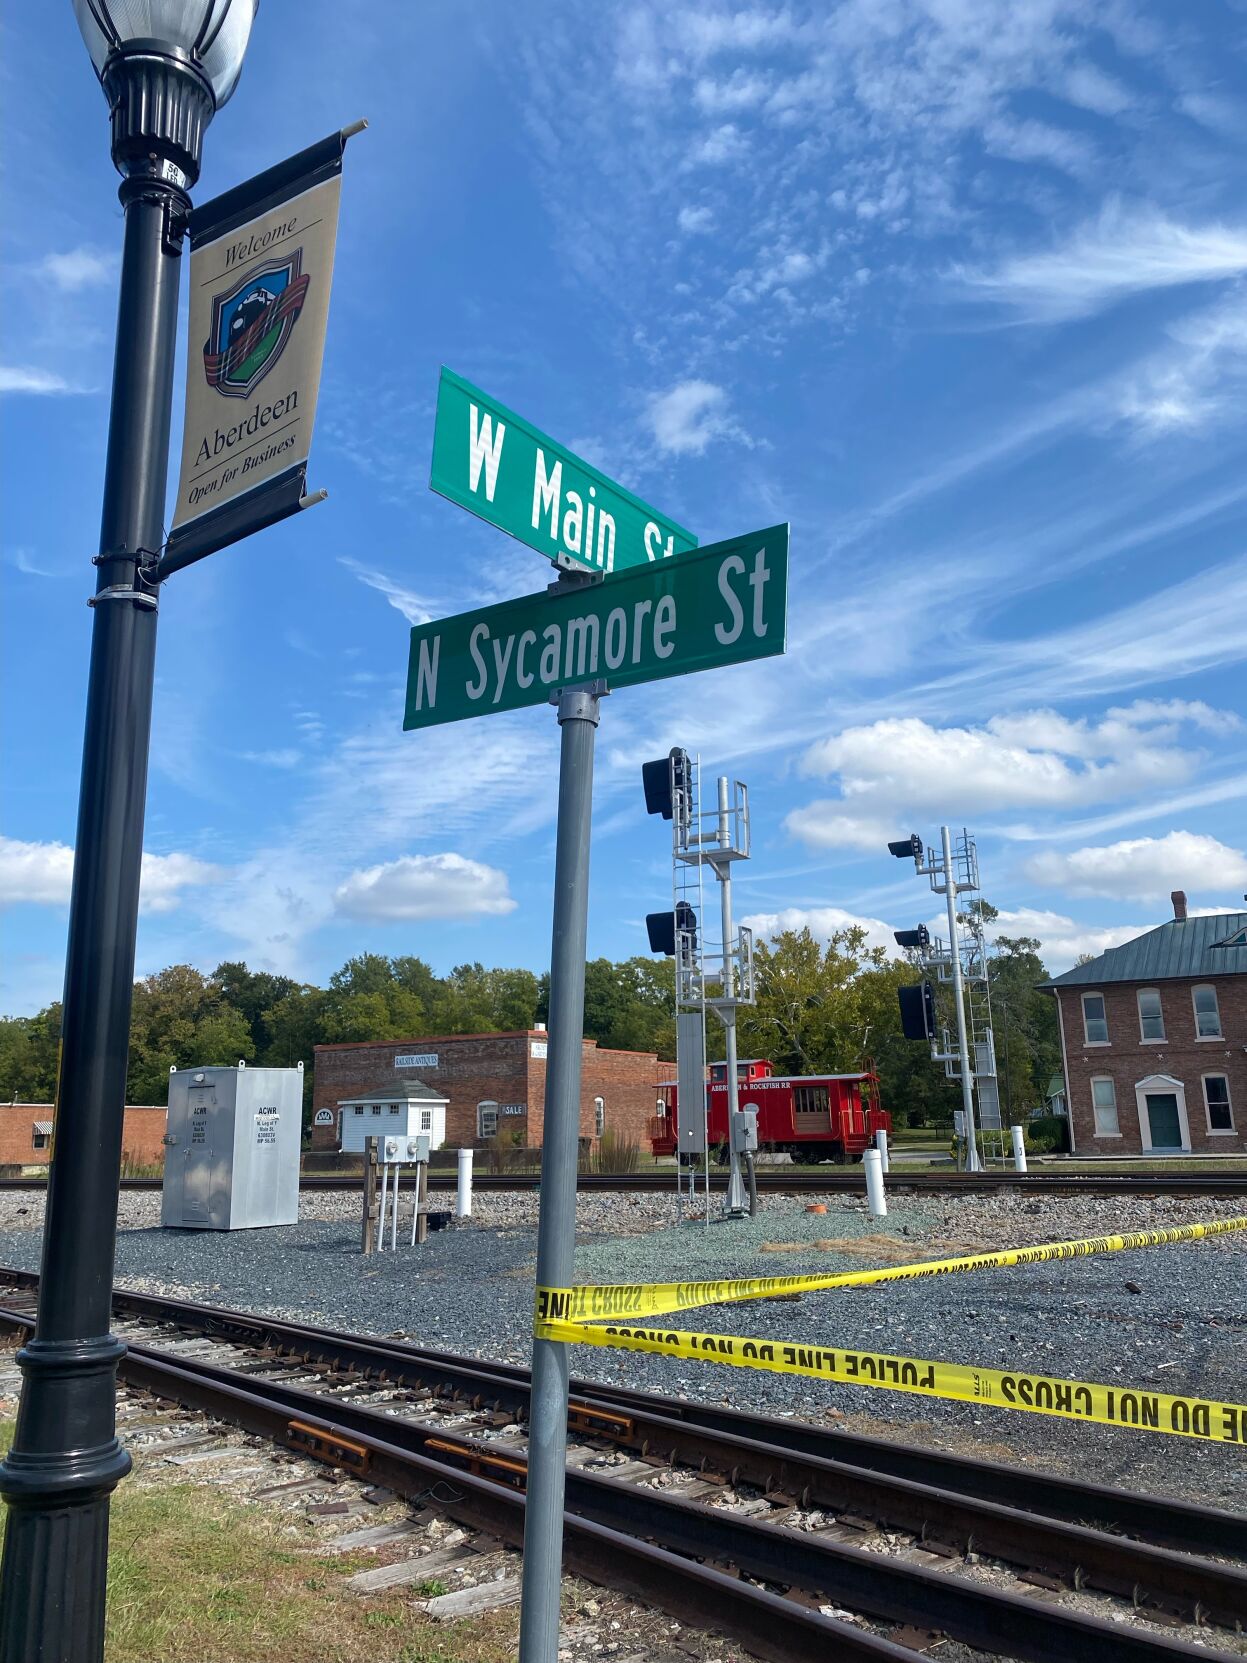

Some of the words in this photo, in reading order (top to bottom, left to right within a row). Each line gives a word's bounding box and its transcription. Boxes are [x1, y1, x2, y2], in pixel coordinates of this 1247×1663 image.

[168, 163, 178, 176] 50
[226, 218, 297, 267] Welcome
[193, 390, 298, 467] Aberdeen
[189, 479, 218, 504] Open
[217, 467, 239, 491] for
[241, 434, 296, 474] Business
[469, 403, 506, 503] W
[531, 447, 616, 572] Main
[415, 634, 441, 711] N
[465, 594, 677, 704] Sycamore
[714, 546, 771, 646] St
[505, 1106, 522, 1114] SALE
[1170, 1400, 1210, 1437] DO
